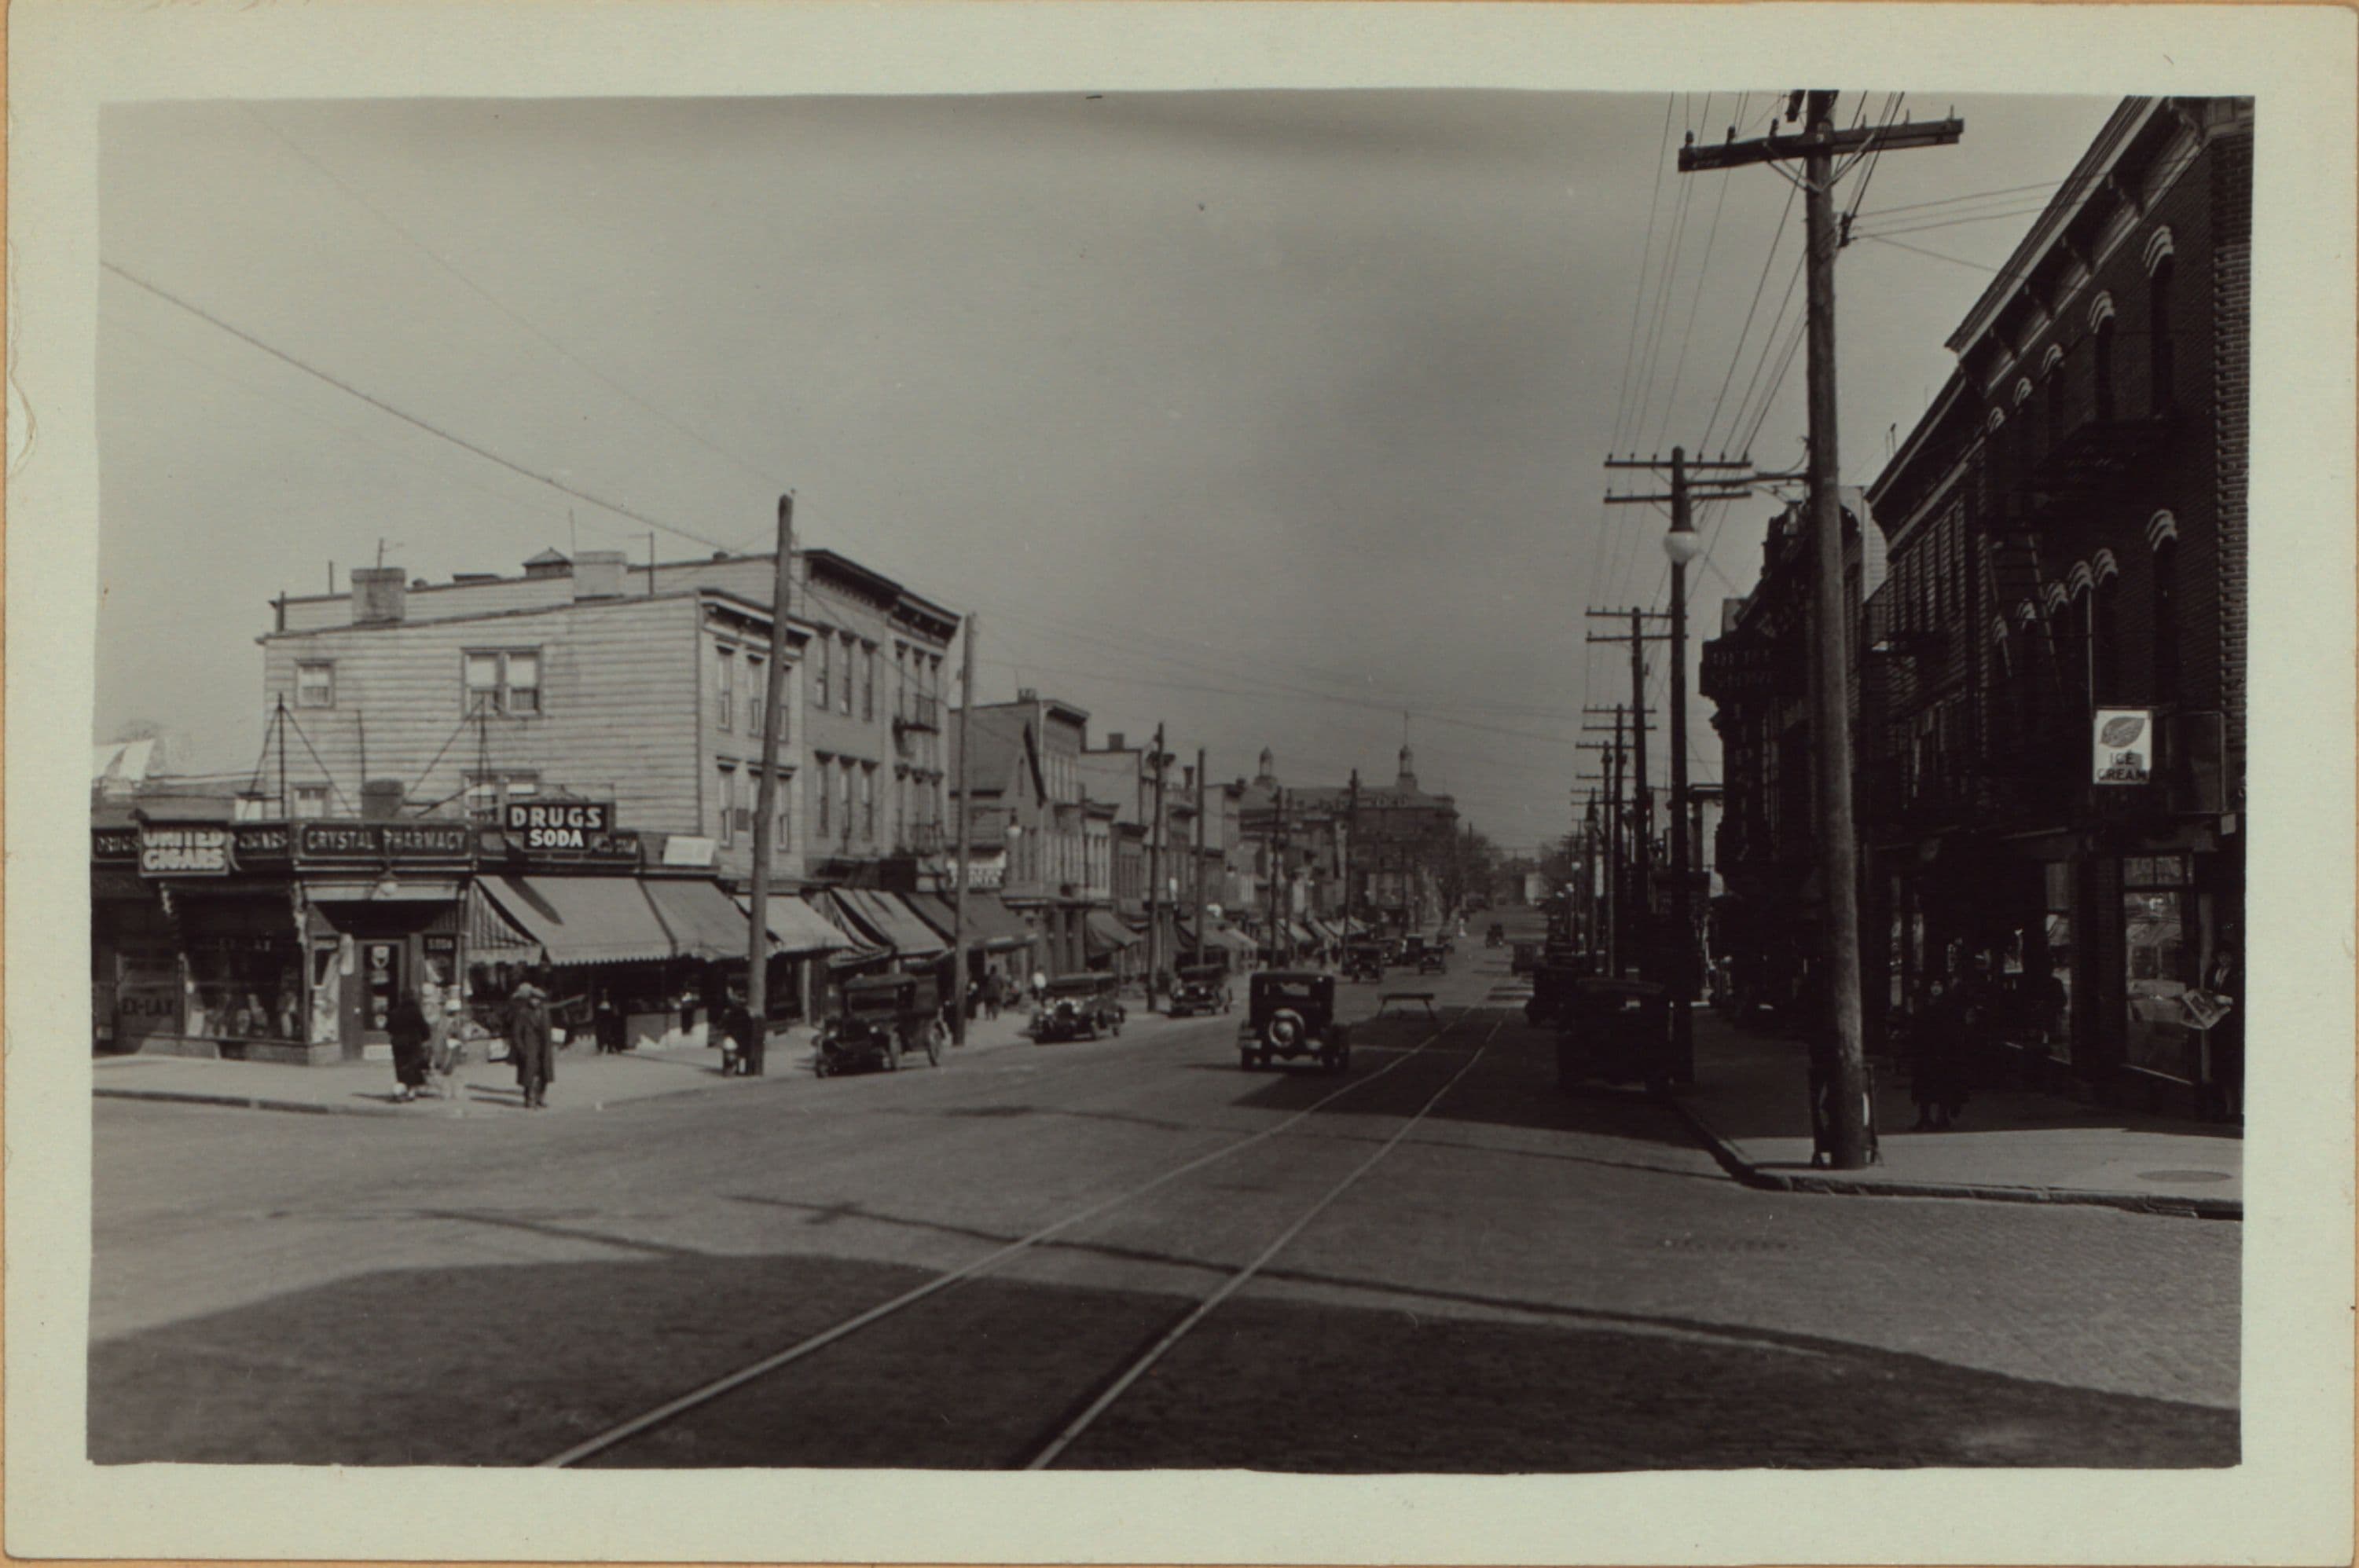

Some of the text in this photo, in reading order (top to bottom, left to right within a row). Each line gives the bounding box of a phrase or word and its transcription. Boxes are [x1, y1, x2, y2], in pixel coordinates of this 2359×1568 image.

[2111, 751, 2134, 765] ICE
[2097, 768, 2147, 781] CREAM
[511, 807, 603, 828] DRUGS
[142, 830, 224, 848] UNITED
[305, 829, 468, 851] CRYSTAL PHARMACY
[528, 829, 585, 848] SODA
[142, 848, 224, 870] CIGARS
